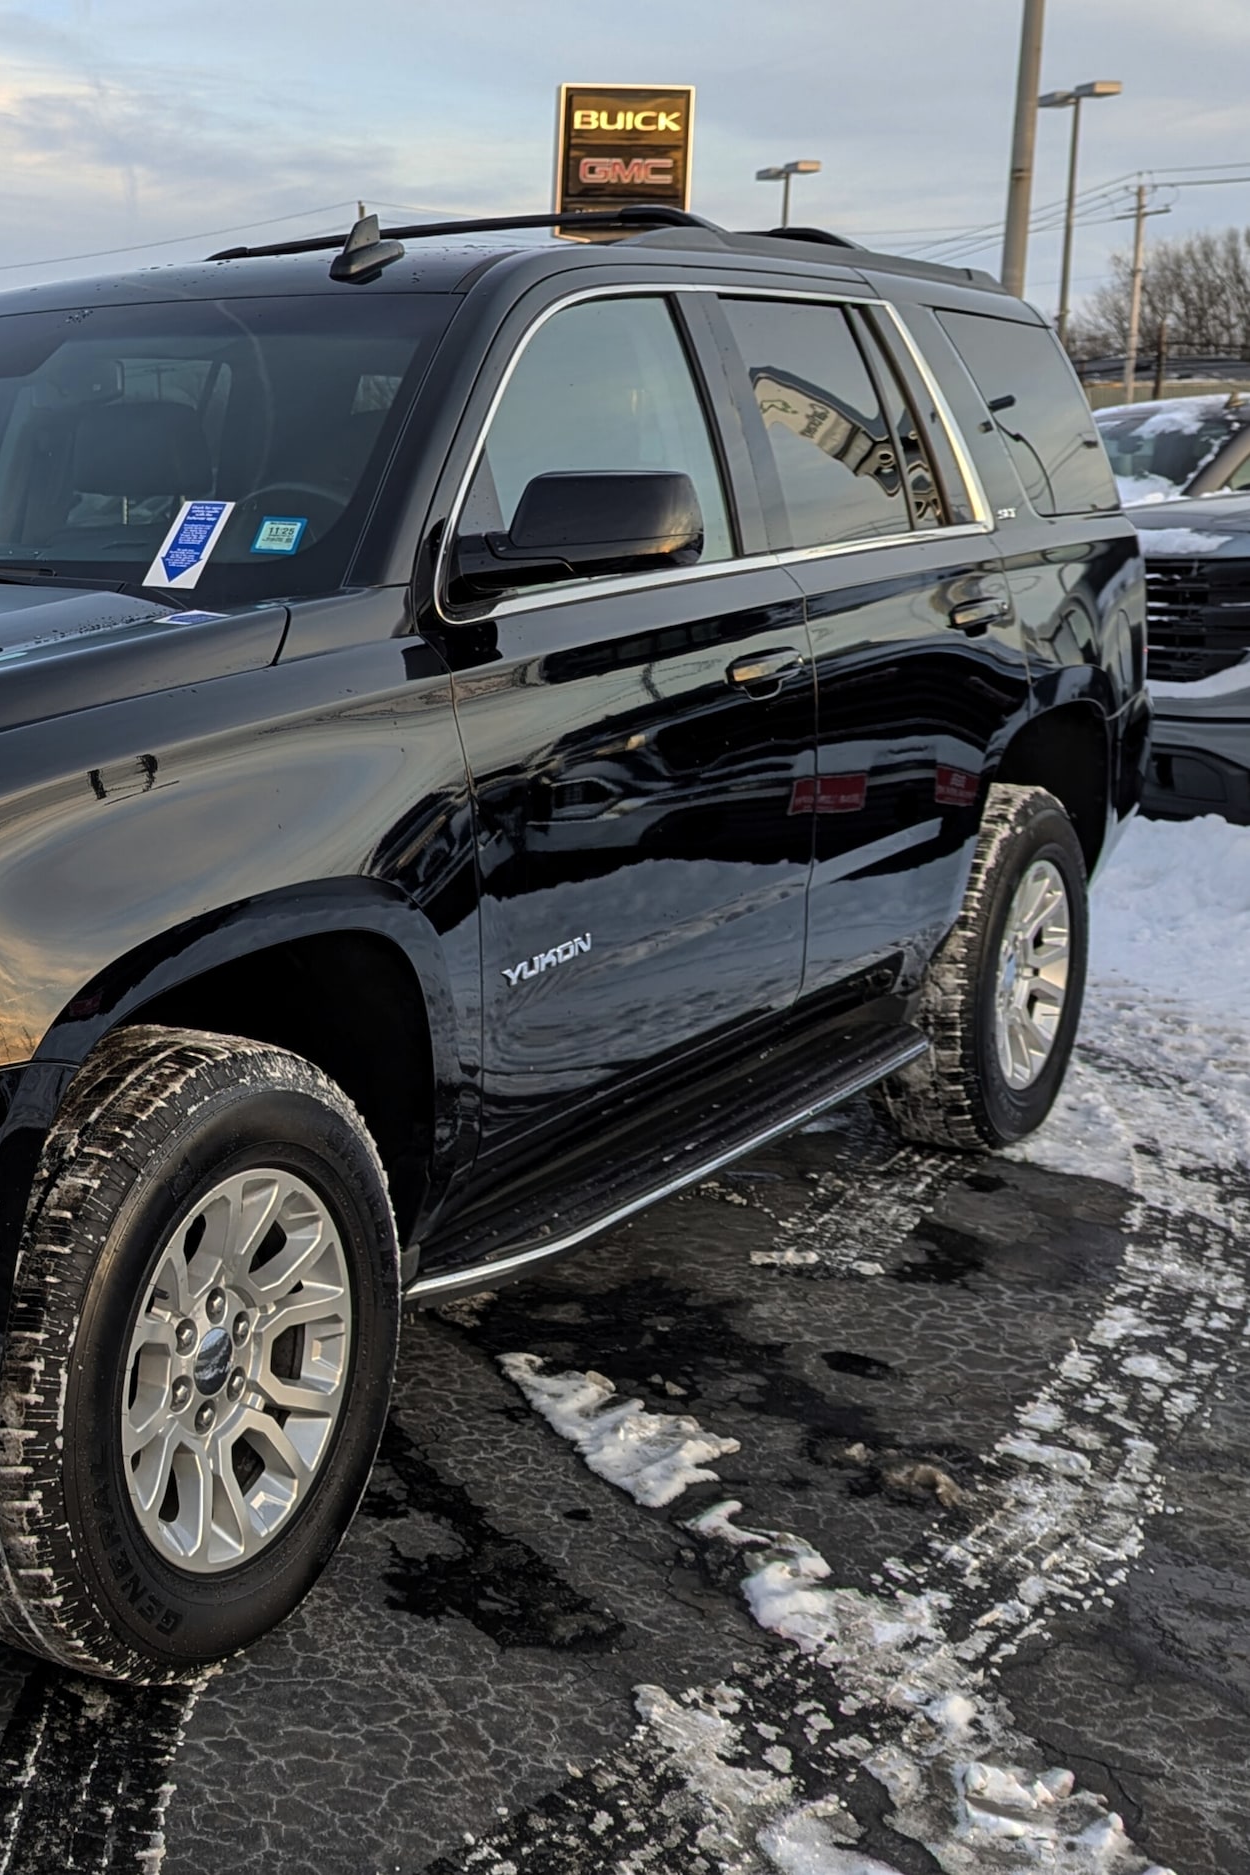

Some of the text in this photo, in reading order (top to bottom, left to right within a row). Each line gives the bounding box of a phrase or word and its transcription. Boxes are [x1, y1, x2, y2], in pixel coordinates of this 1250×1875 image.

[573, 110, 682, 131] BUICK
[579, 158, 674, 184] GMC
[500, 932, 592, 986] YUKON
[90, 1442, 183, 1636] GENERAL
